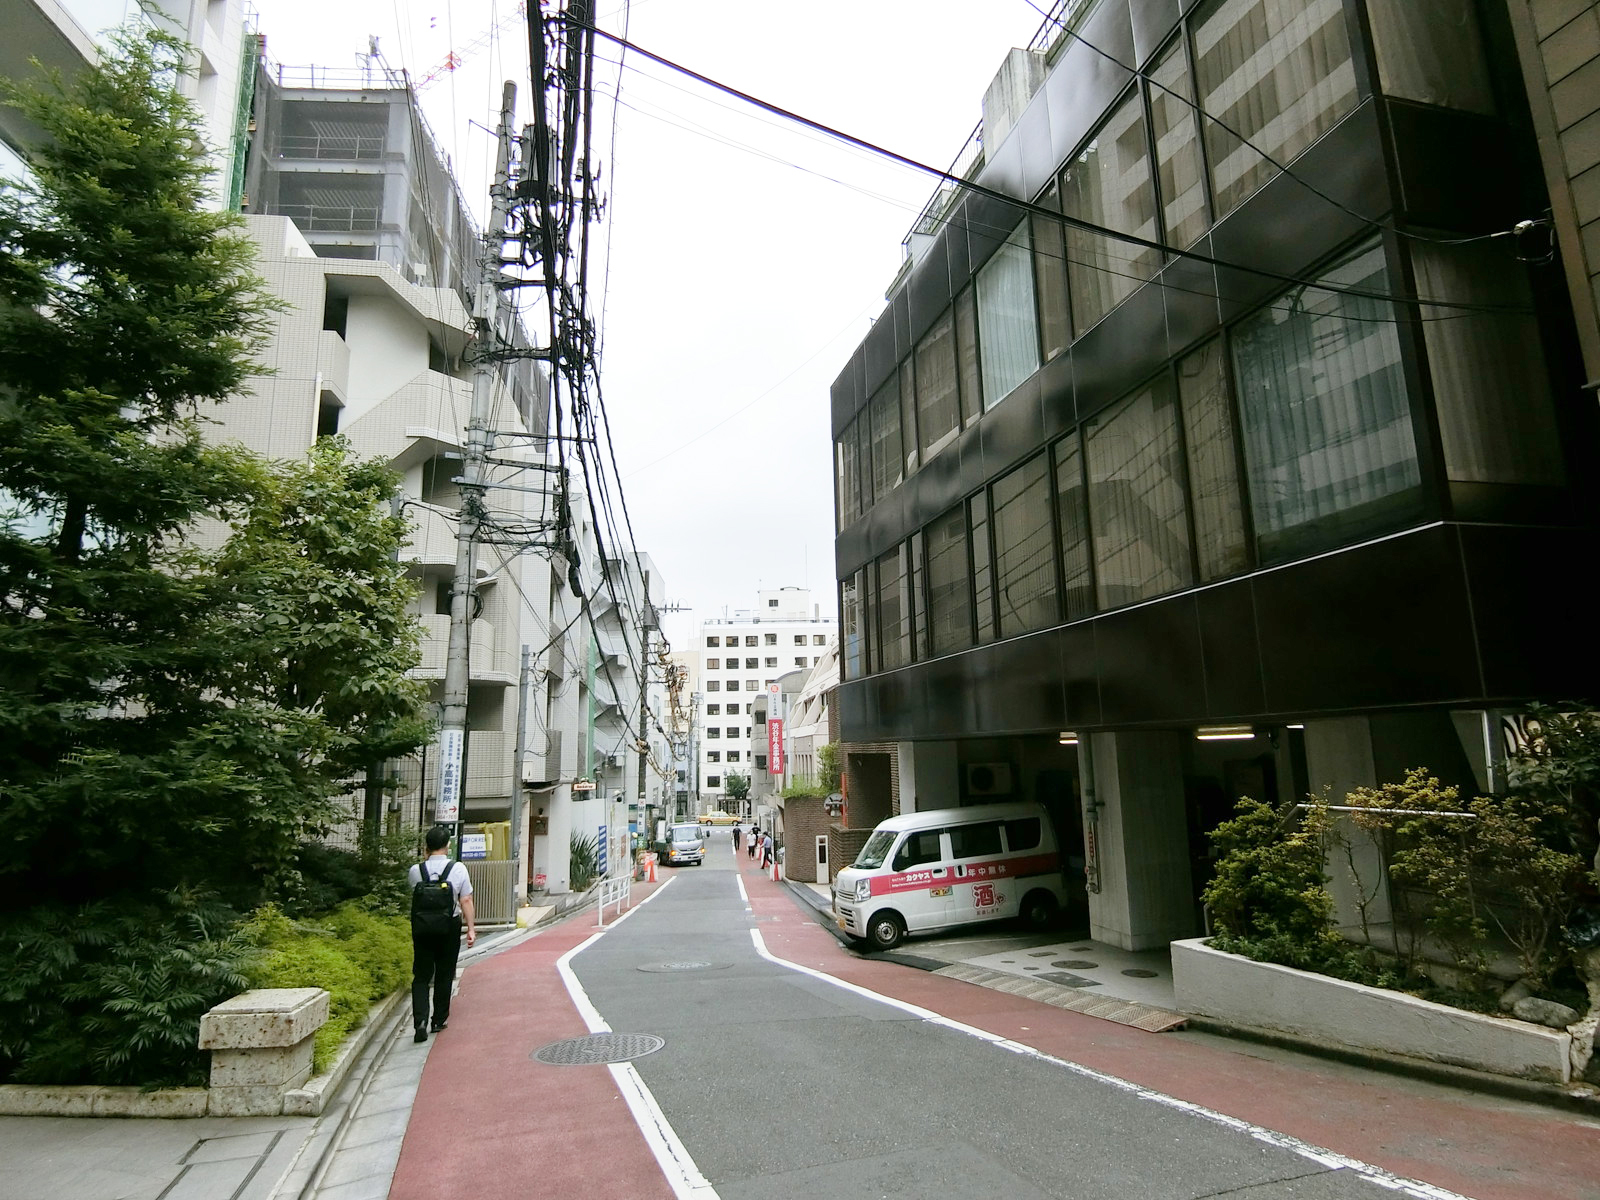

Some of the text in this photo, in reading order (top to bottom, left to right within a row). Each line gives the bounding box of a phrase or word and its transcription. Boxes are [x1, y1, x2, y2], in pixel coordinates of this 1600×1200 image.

[772, 722, 780, 770] 渋谷年金事務所
[442, 761, 454, 803] 小高事務所
[906, 872, 930, 882] カクヤス
[968, 865, 1007, 877] 年中無休
